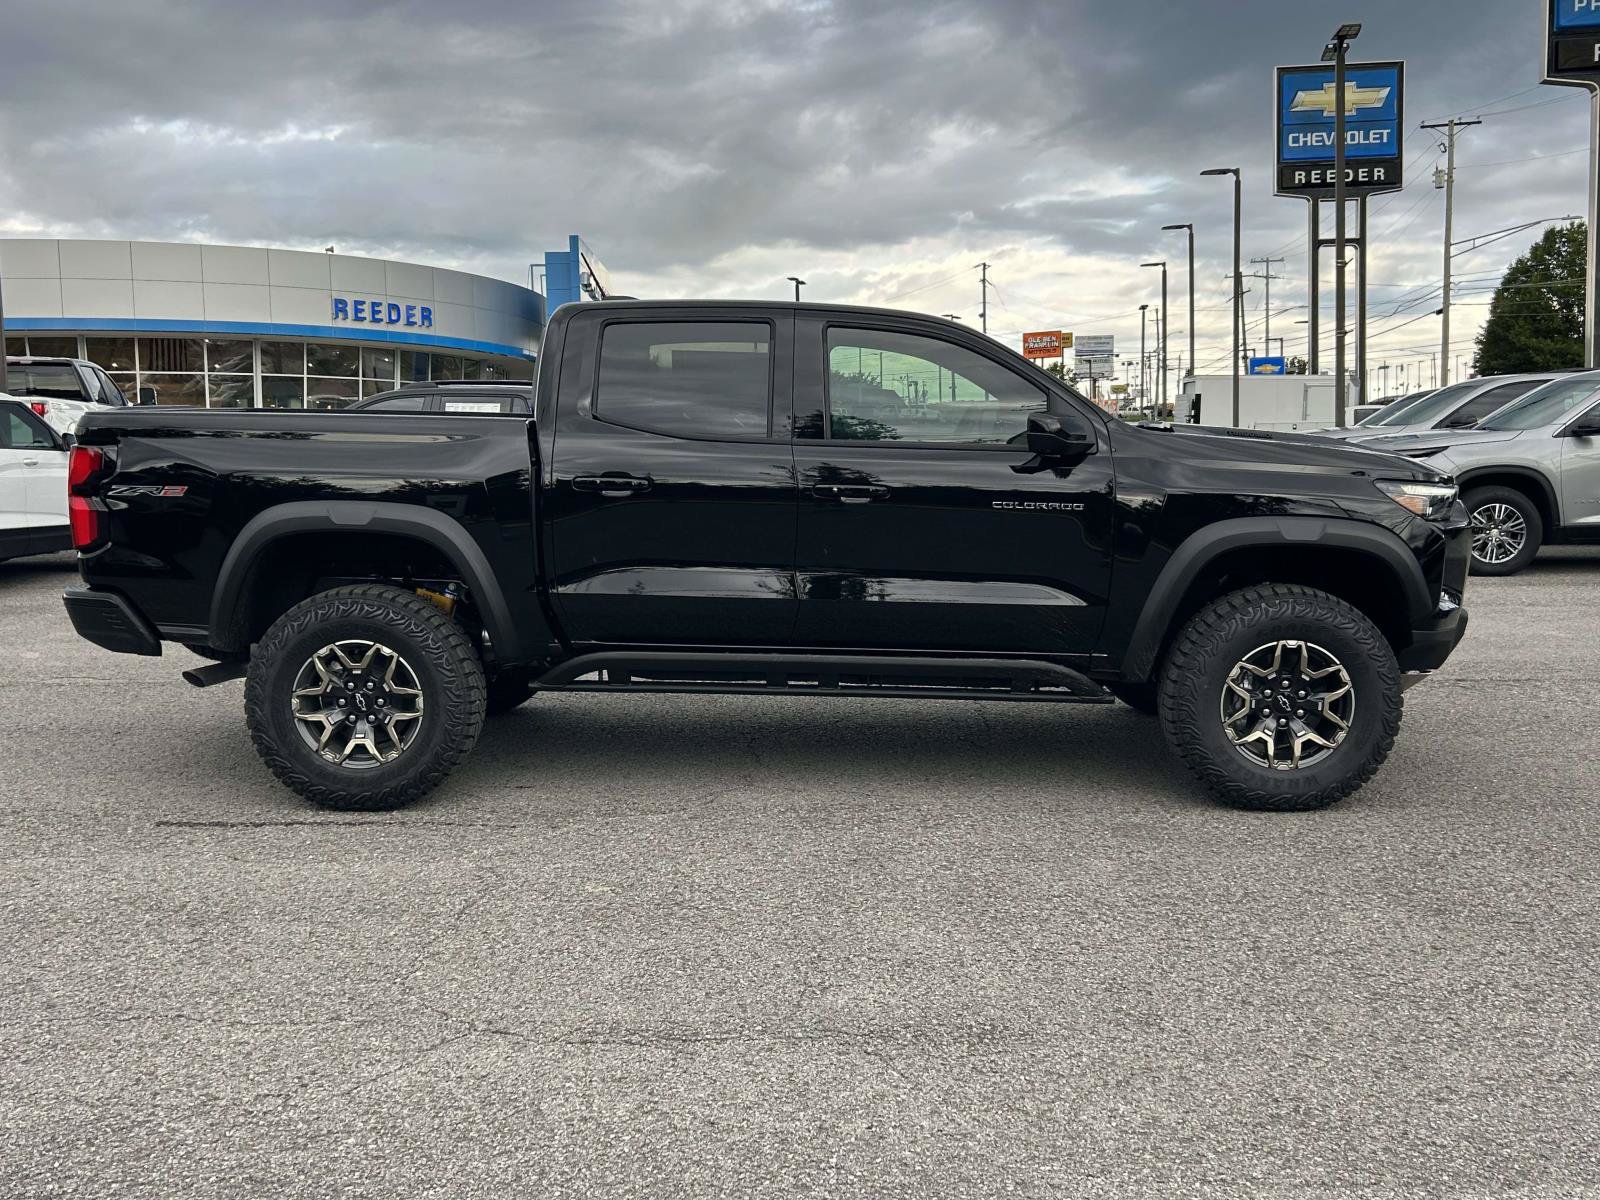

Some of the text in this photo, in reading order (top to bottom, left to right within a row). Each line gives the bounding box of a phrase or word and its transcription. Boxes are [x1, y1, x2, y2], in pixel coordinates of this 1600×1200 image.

[1288, 129, 1391, 147] CHEVOLET
[334, 298, 433, 328] REEDER
[1025, 341, 1059, 349] FRANKLIN
[107, 485, 188, 496] ZR2
[992, 501, 1085, 510] COLORADO
